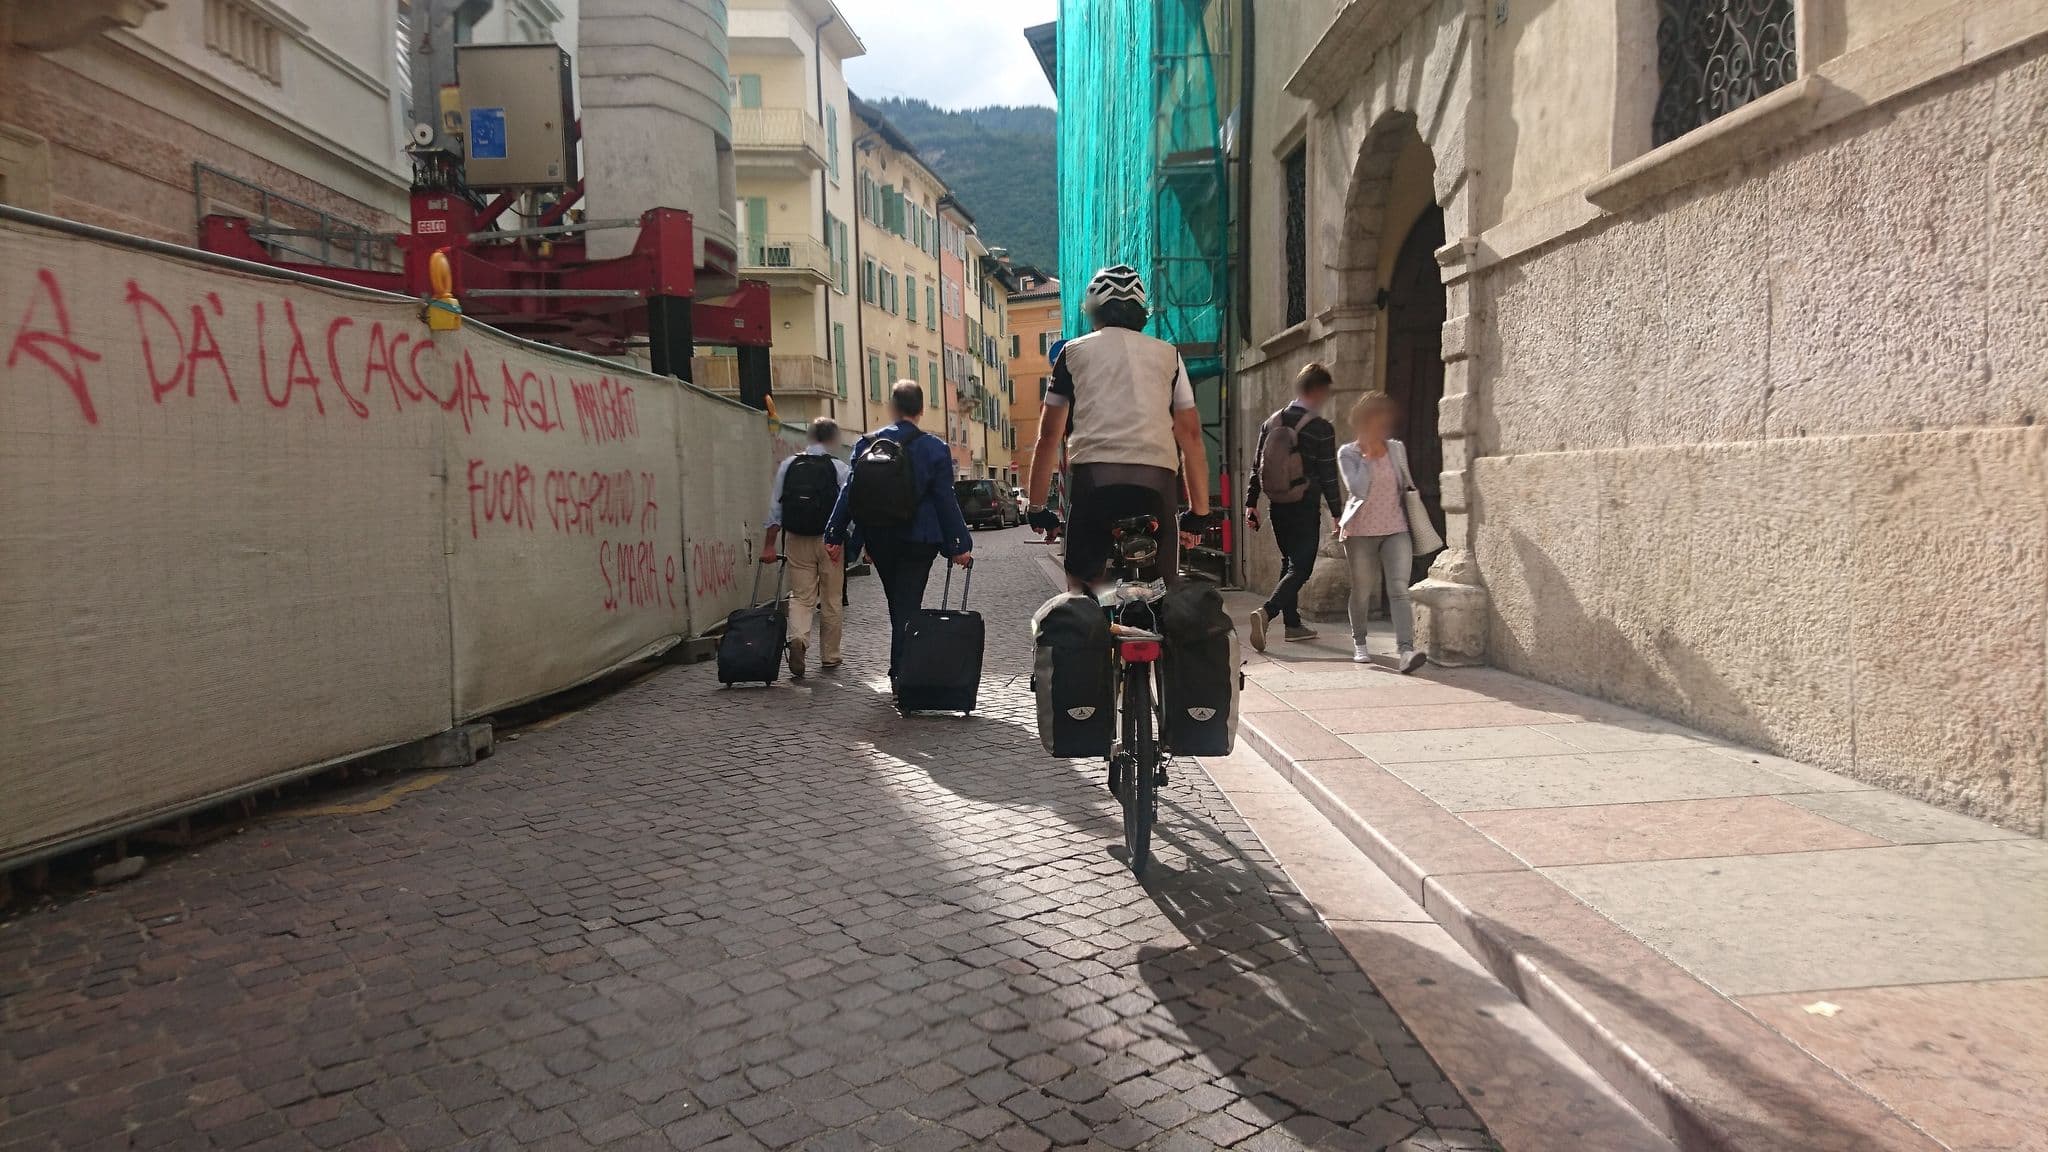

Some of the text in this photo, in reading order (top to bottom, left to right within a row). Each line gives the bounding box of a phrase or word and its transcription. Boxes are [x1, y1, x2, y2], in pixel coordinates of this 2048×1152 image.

[327, 316, 490, 434] CACCIA
[501, 360, 564, 432] AGLI
[467, 459, 535, 540] FUORI
